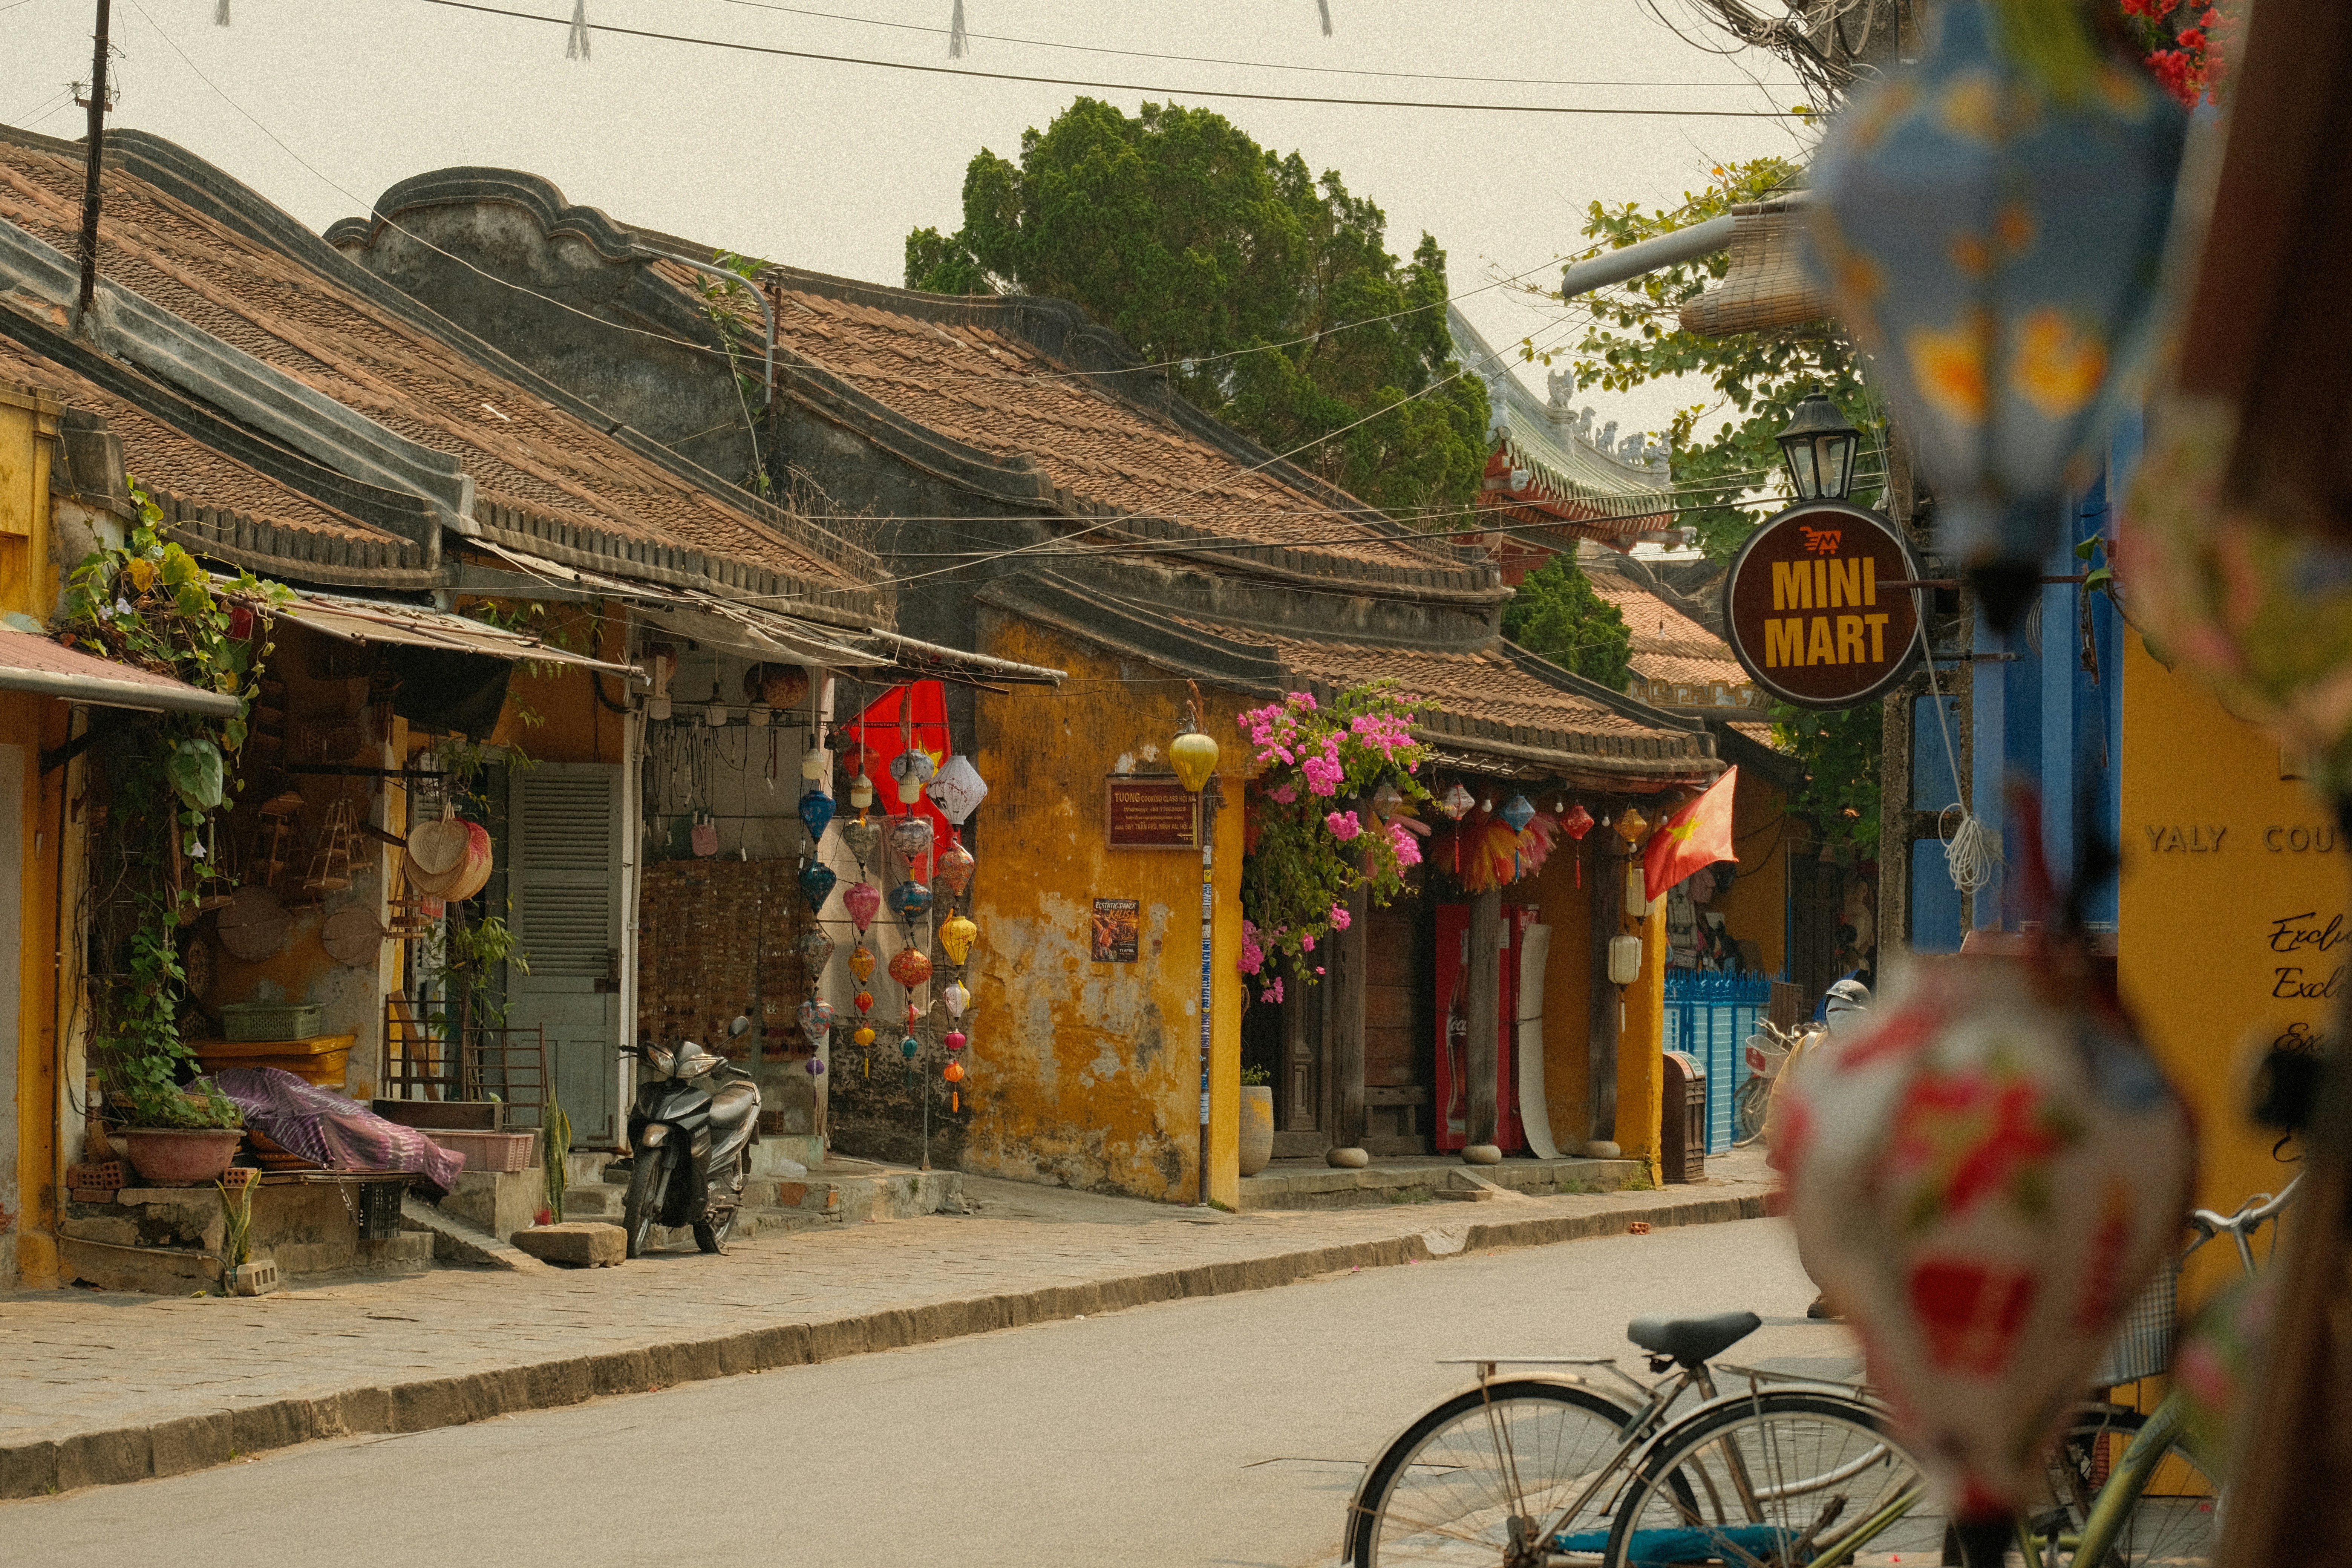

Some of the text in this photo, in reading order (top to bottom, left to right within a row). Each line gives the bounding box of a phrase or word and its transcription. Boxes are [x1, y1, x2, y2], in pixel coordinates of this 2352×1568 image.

[1772, 557, 1876, 610] MINI
[1764, 613, 1889, 668] MART
[1115, 792, 1140, 802] TUONG
[2145, 825, 2334, 852] YALY COU
[1109, 909, 1135, 920] KALISA
[2272, 965, 2346, 998] Excl
[2274, 1022, 2326, 1053] Ex
